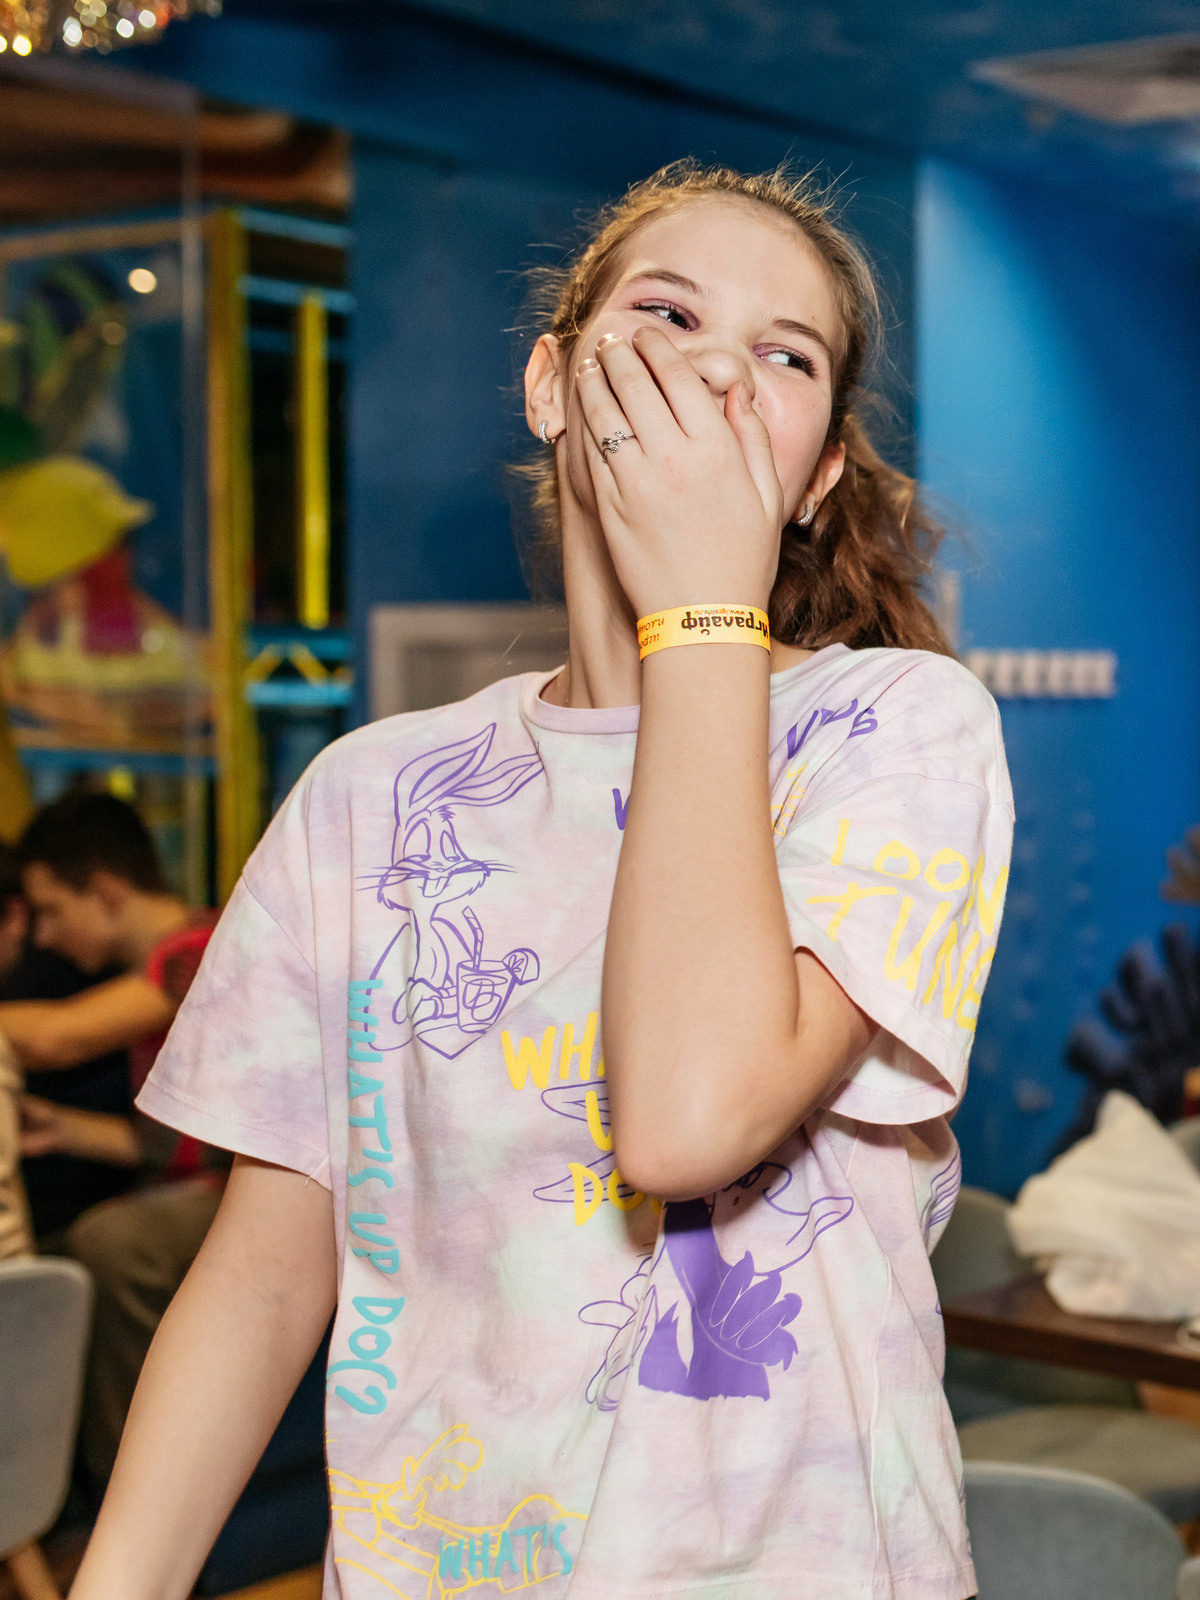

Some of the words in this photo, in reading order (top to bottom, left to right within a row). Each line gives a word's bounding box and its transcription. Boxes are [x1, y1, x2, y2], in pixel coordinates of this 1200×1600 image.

[681, 611, 769, 639] Игралайф
[501, 1011, 605, 1091] WH
[347, 979, 395, 1189] WHAT'S
[568, 1162, 662, 1226] DO
[349, 1211, 400, 1274] UP
[438, 1523, 574, 1579] WHAT'S
